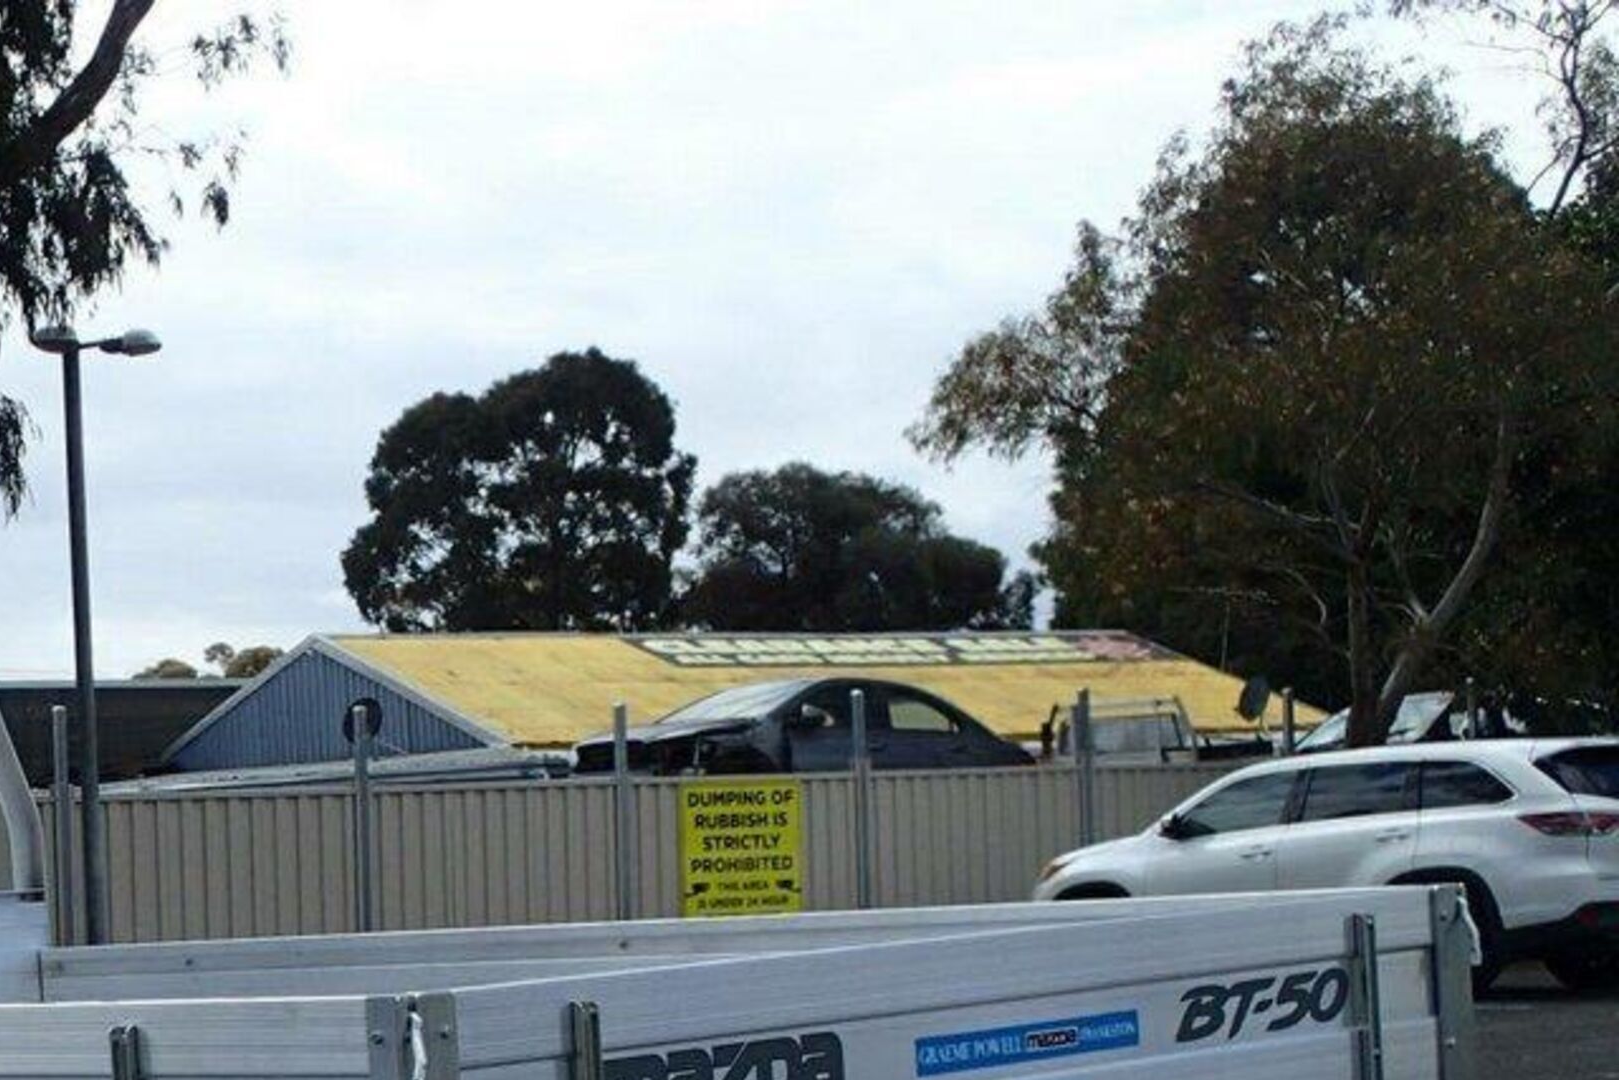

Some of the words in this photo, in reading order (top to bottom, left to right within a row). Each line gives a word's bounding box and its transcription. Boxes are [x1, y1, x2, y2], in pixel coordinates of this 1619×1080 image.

[687, 791, 767, 807] DUMPING
[771, 788, 794, 805] OF
[694, 814, 768, 830] RUBBISH
[773, 812, 788, 827] IS
[702, 834, 780, 851] STRICTLY
[690, 855, 793, 872] PROHIBITED
[1175, 967, 1350, 1042] BT-50
